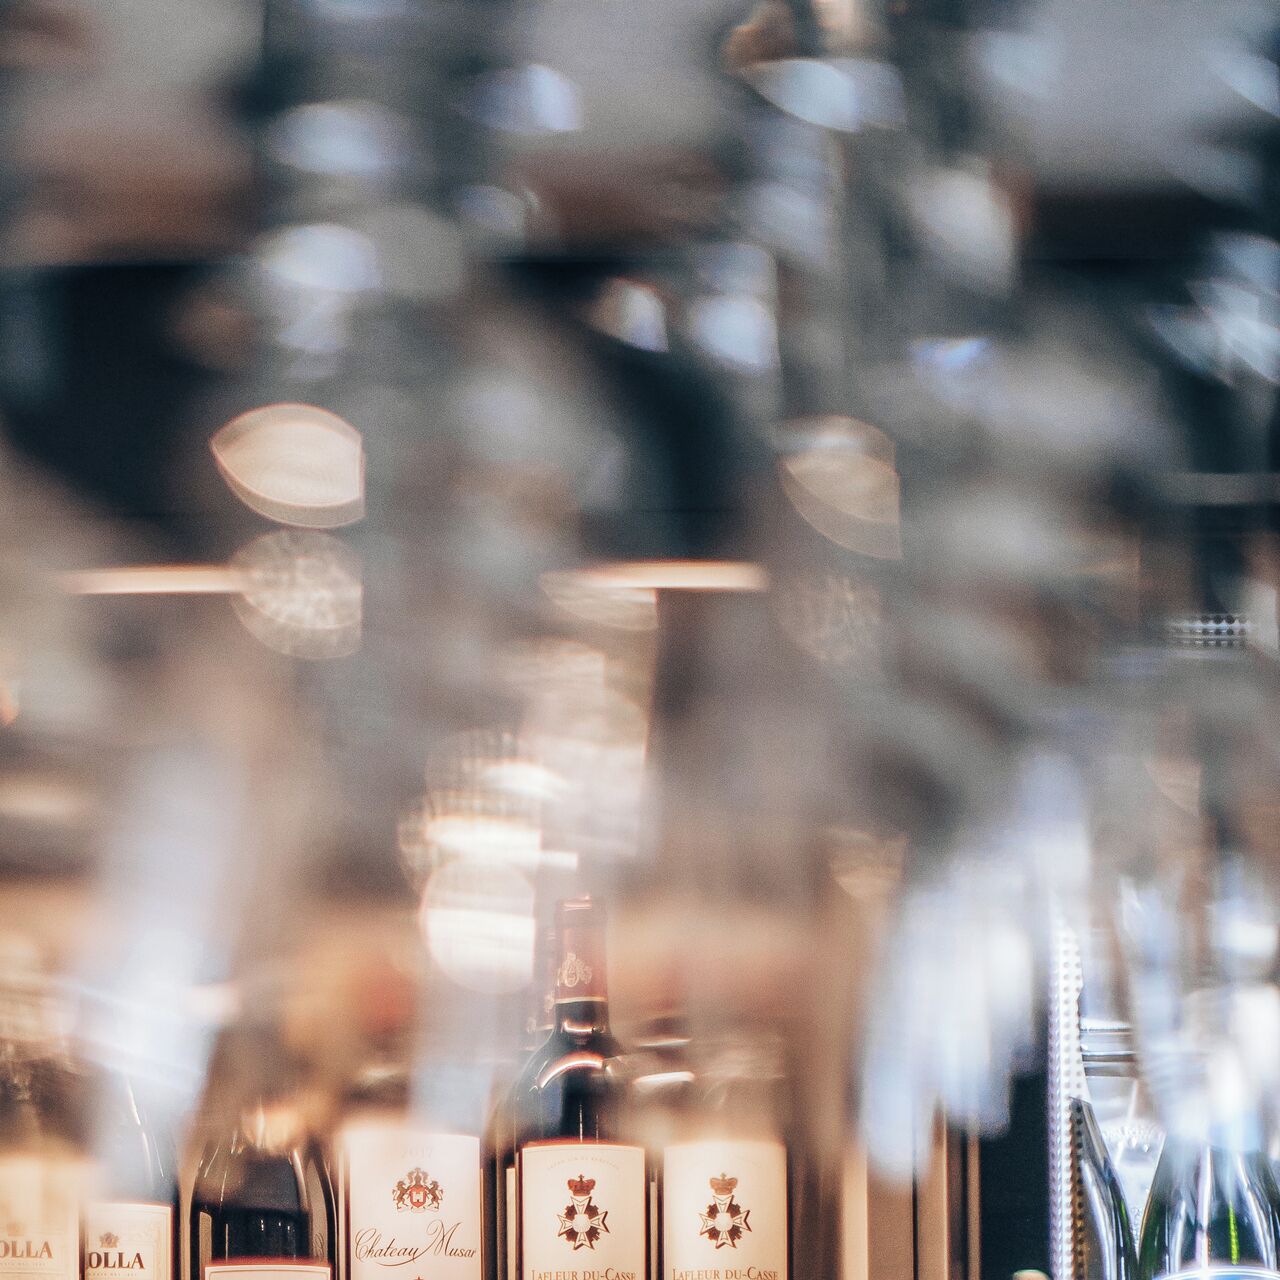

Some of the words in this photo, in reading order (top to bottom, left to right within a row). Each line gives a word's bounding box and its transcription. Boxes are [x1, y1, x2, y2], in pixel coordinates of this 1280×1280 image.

[355, 1228, 418, 1263] Chateau
[424, 1219, 477, 1260] Musar
[86, 1251, 145, 1269] OLLA
